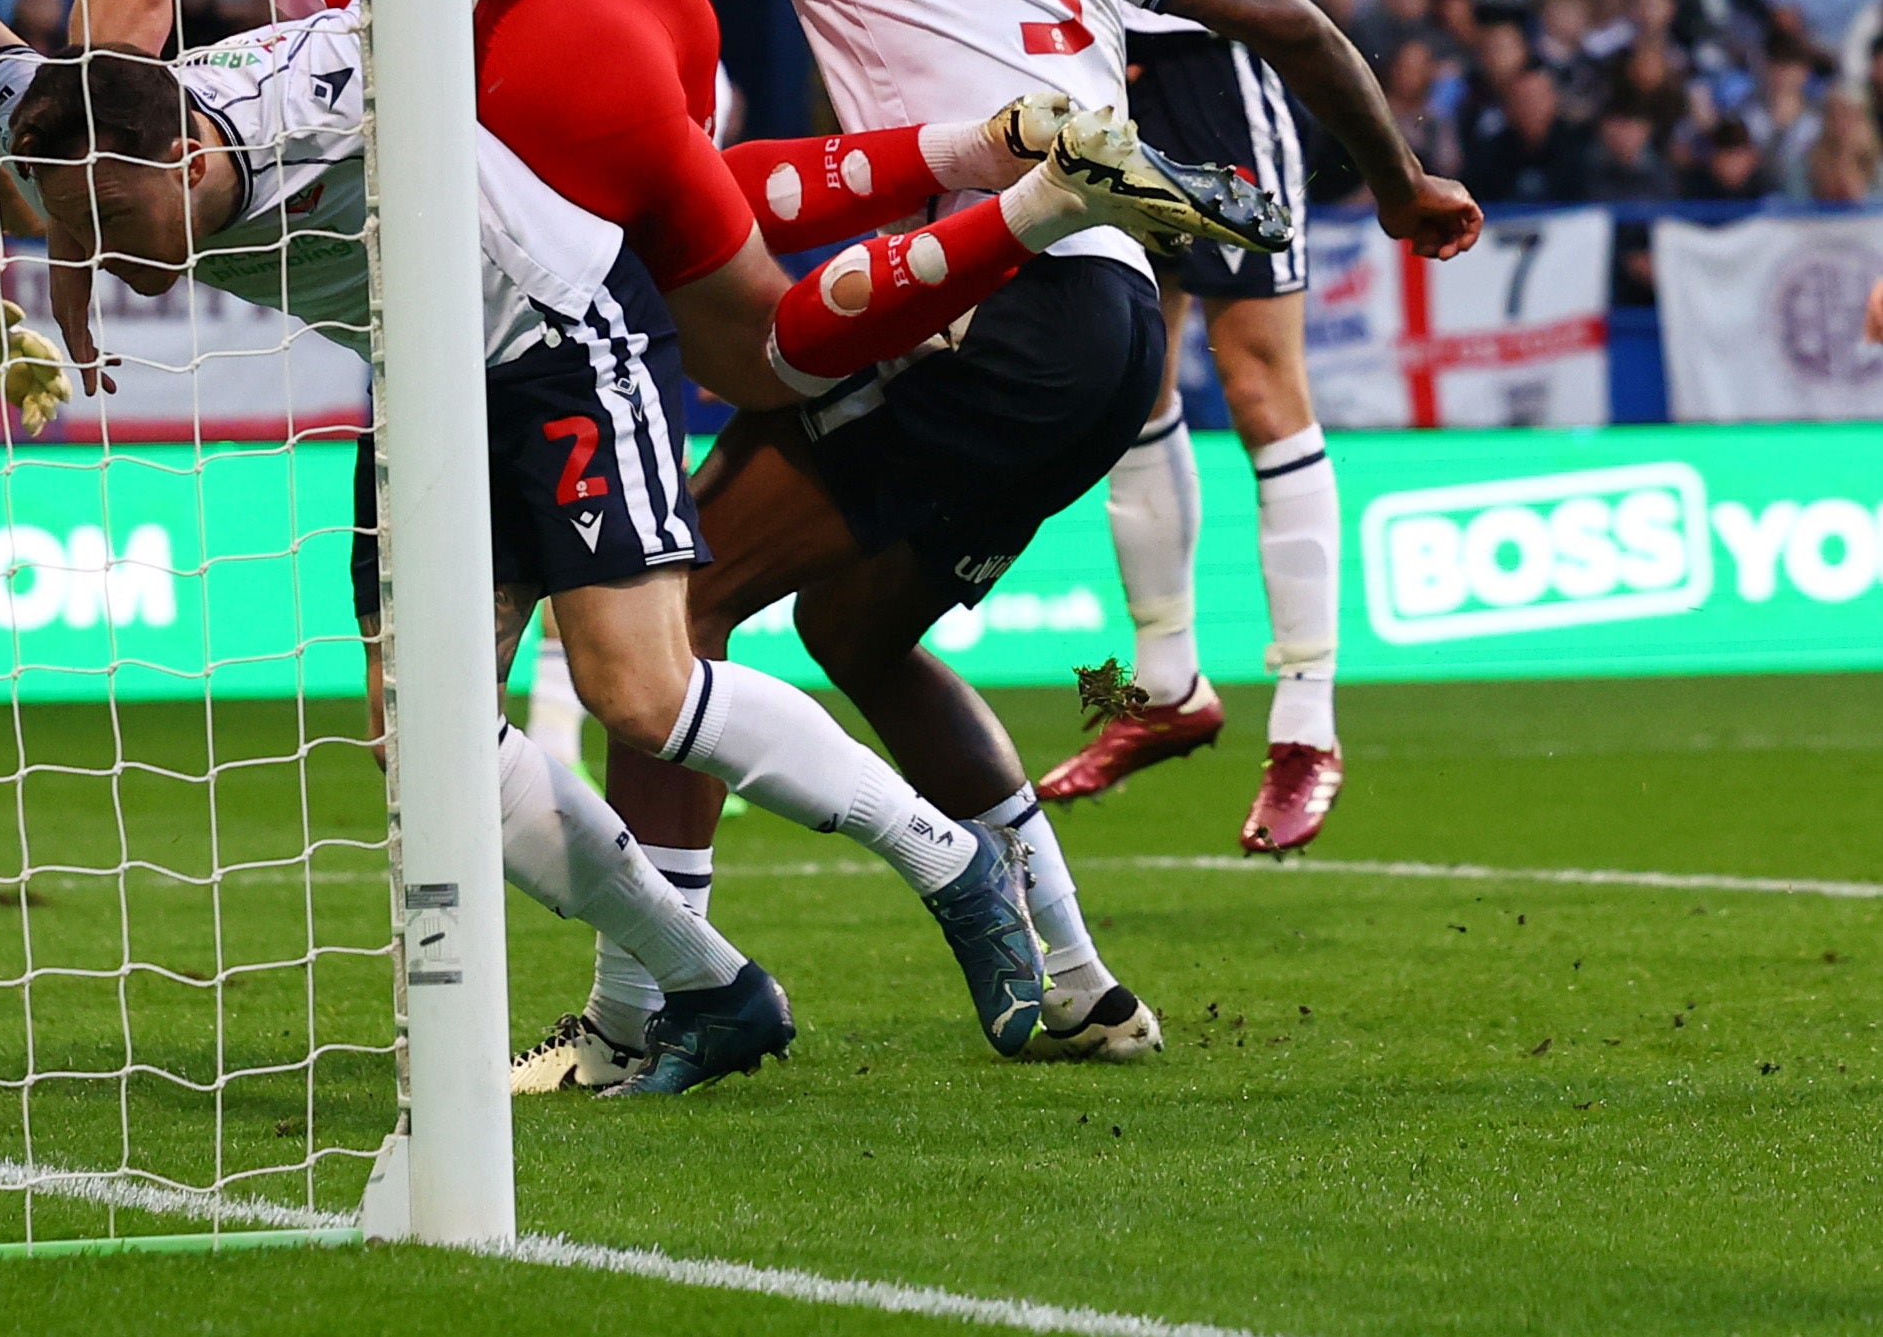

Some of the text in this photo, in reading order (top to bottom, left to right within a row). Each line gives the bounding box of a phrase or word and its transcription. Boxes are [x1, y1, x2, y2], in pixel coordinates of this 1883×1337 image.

[825, 138, 842, 190] BFC
[1489, 224, 1541, 321] 7
[543, 415, 609, 505] 2
[1390, 488, 1883, 616] BOSS YO
